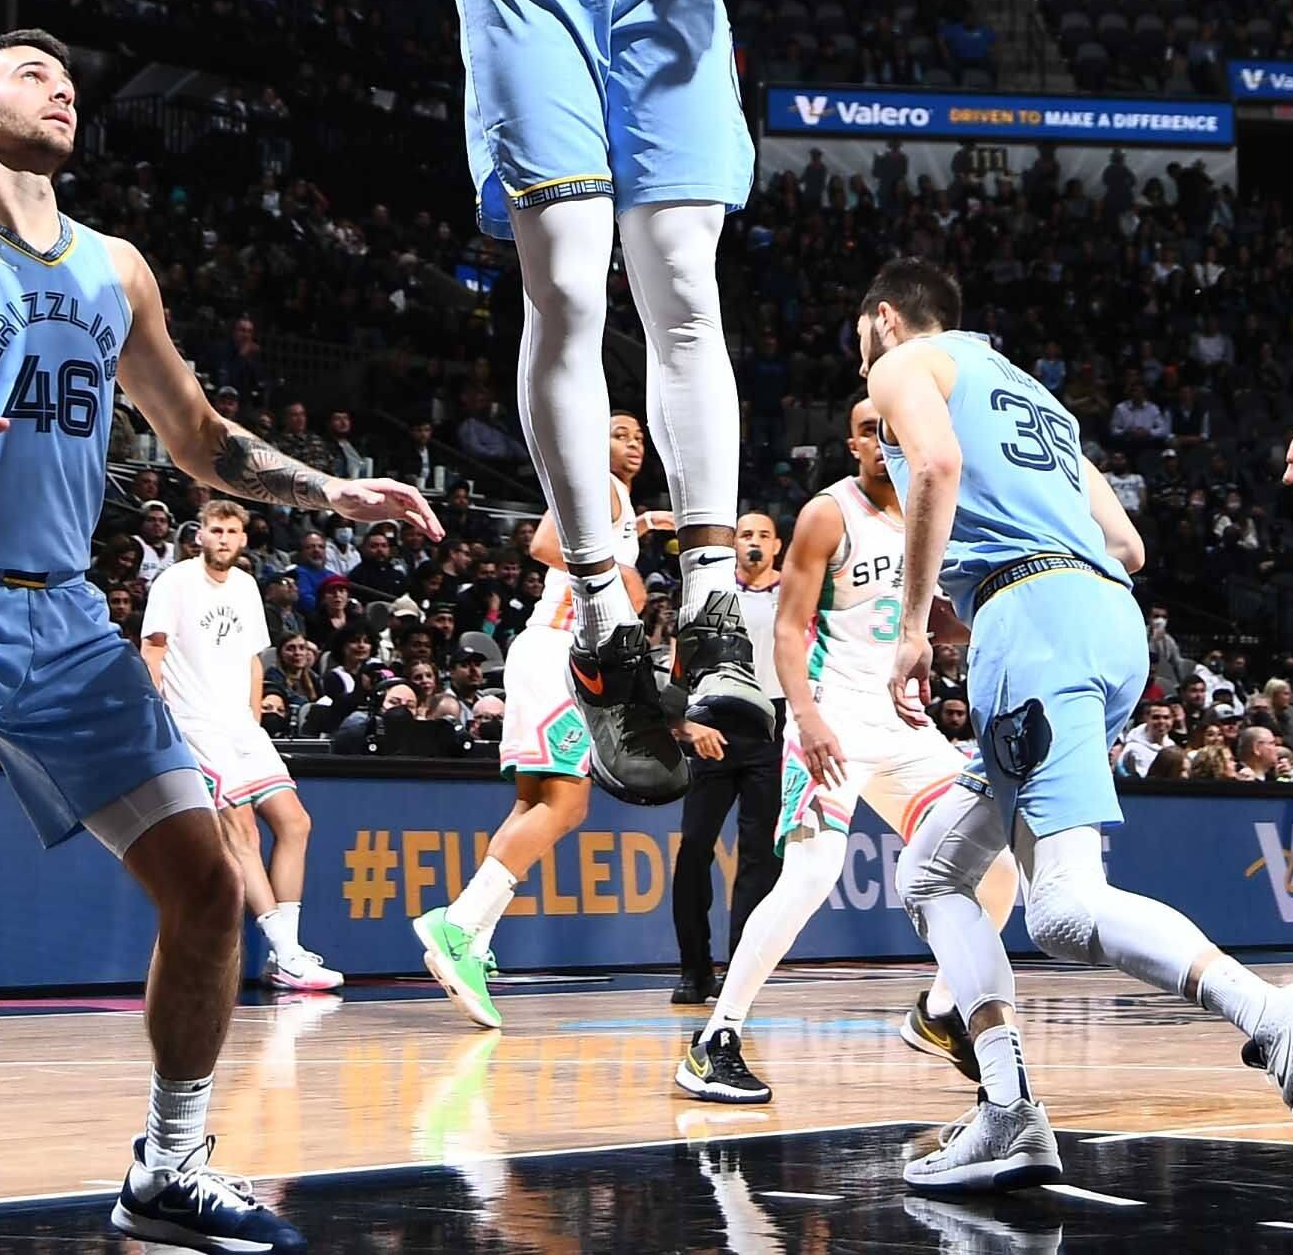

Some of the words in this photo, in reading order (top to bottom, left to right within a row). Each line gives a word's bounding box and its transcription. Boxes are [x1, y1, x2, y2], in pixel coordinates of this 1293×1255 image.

[835, 100, 931, 127] Valero
[948, 107, 1014, 125] DRIVEN
[1018, 109, 1041, 125] TO
[1044, 110, 1094, 128] MAKE
[1097, 111, 1111, 128] A
[1113, 113, 1219, 133] DIFFERENCE
[1, 354, 100, 439] 46
